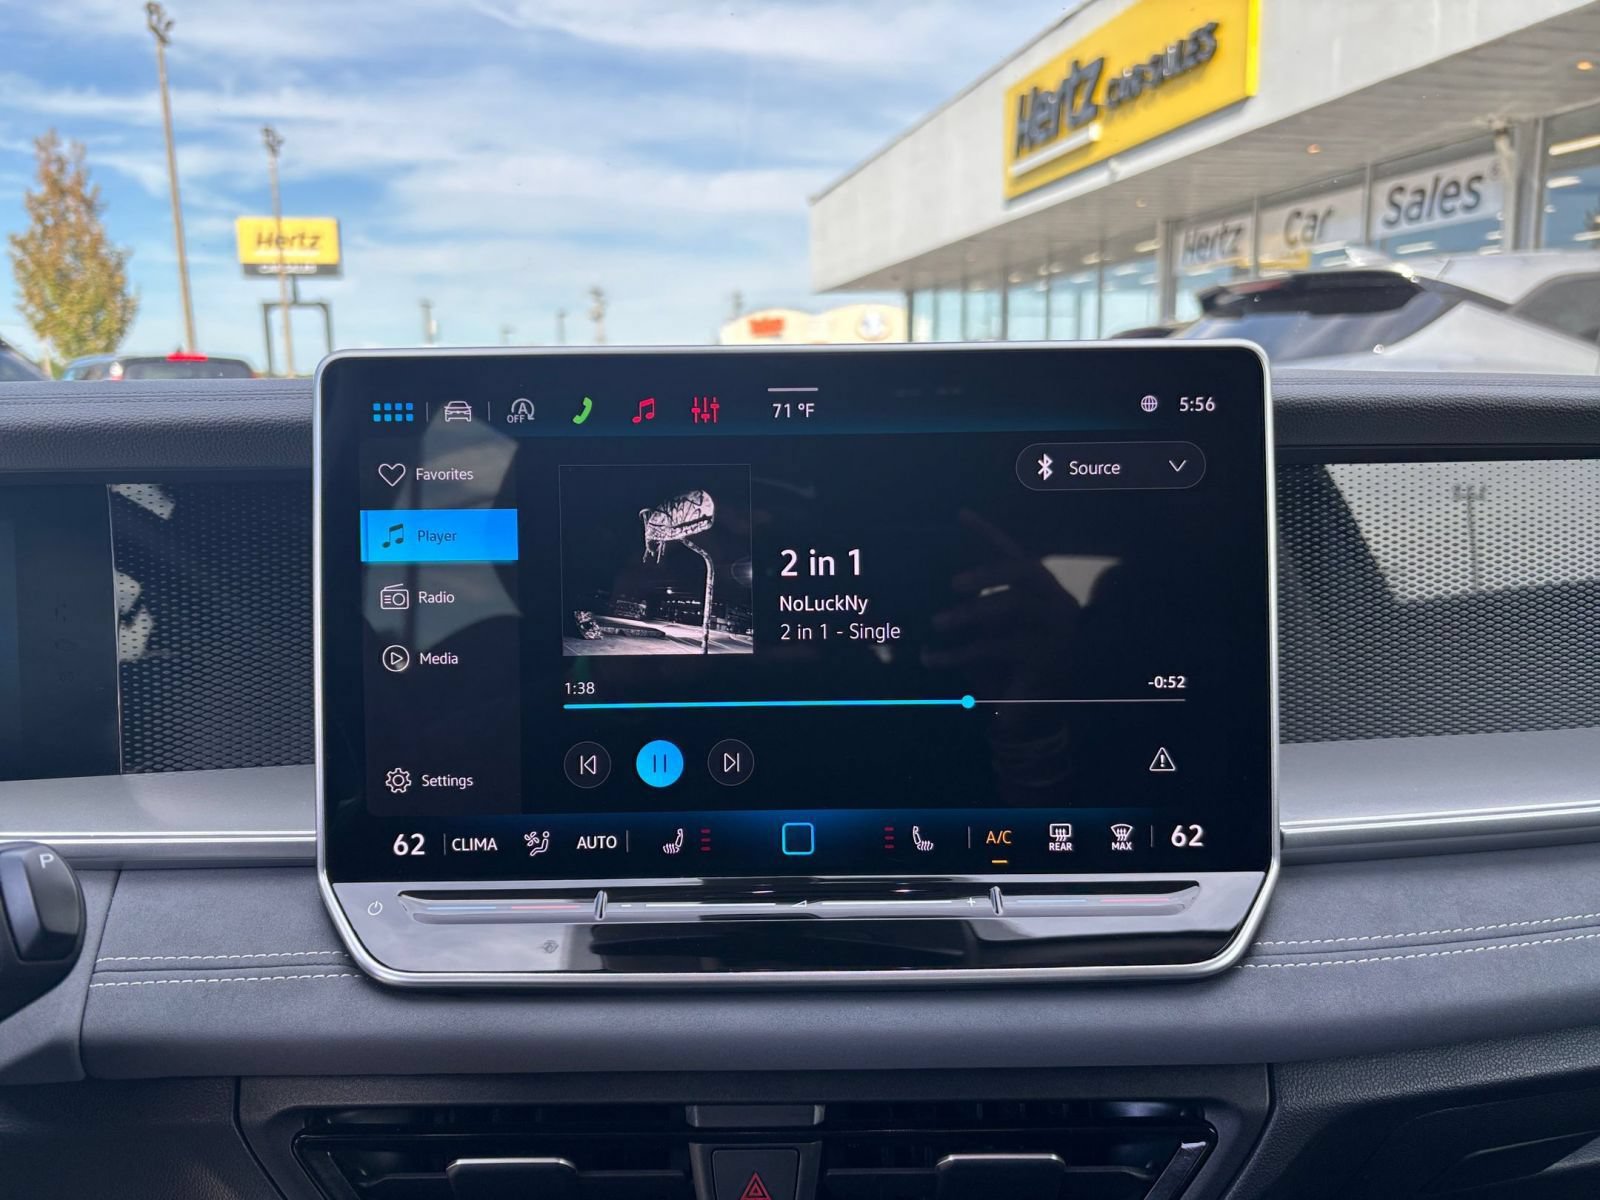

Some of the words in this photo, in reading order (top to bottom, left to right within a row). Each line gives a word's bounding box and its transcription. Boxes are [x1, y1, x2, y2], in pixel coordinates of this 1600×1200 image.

[1016, 56, 1105, 158] Hertz
[1181, 219, 1244, 265] Hertz
[1283, 206, 1334, 247] Car
[1382, 171, 1483, 228] Sales
[255, 231, 322, 251] Hertz
[772, 403, 791, 418] 71
[1180, 397, 1216, 412] 5:56
[506, 414, 526, 423] OFF
[415, 467, 475, 482] Favorites
[1069, 460, 1121, 476] Source
[416, 528, 457, 545] Player
[780, 549, 798, 576] 2
[809, 548, 835, 576] in
[848, 549, 861, 576] 1
[418, 590, 455, 604] Radio
[779, 595, 868, 615] NoLuckNy
[780, 624, 791, 640] 2
[797, 624, 812, 640] in
[819, 624, 828, 640] 1
[849, 623, 901, 644] Single
[419, 651, 459, 665] Media
[564, 681, 595, 695] 1:38
[1148, 675, 1186, 689] -0:52
[421, 773, 474, 790] Settings
[576, 835, 618, 850] AUTO
[985, 829, 1012, 846] A/C
[1170, 824, 1204, 848] 62
[392, 832, 426, 856] 62
[451, 837, 498, 852] CLIMA
[1048, 842, 1073, 852] REAR
[1111, 842, 1133, 851] MAX
[40, 854, 54, 868] P
